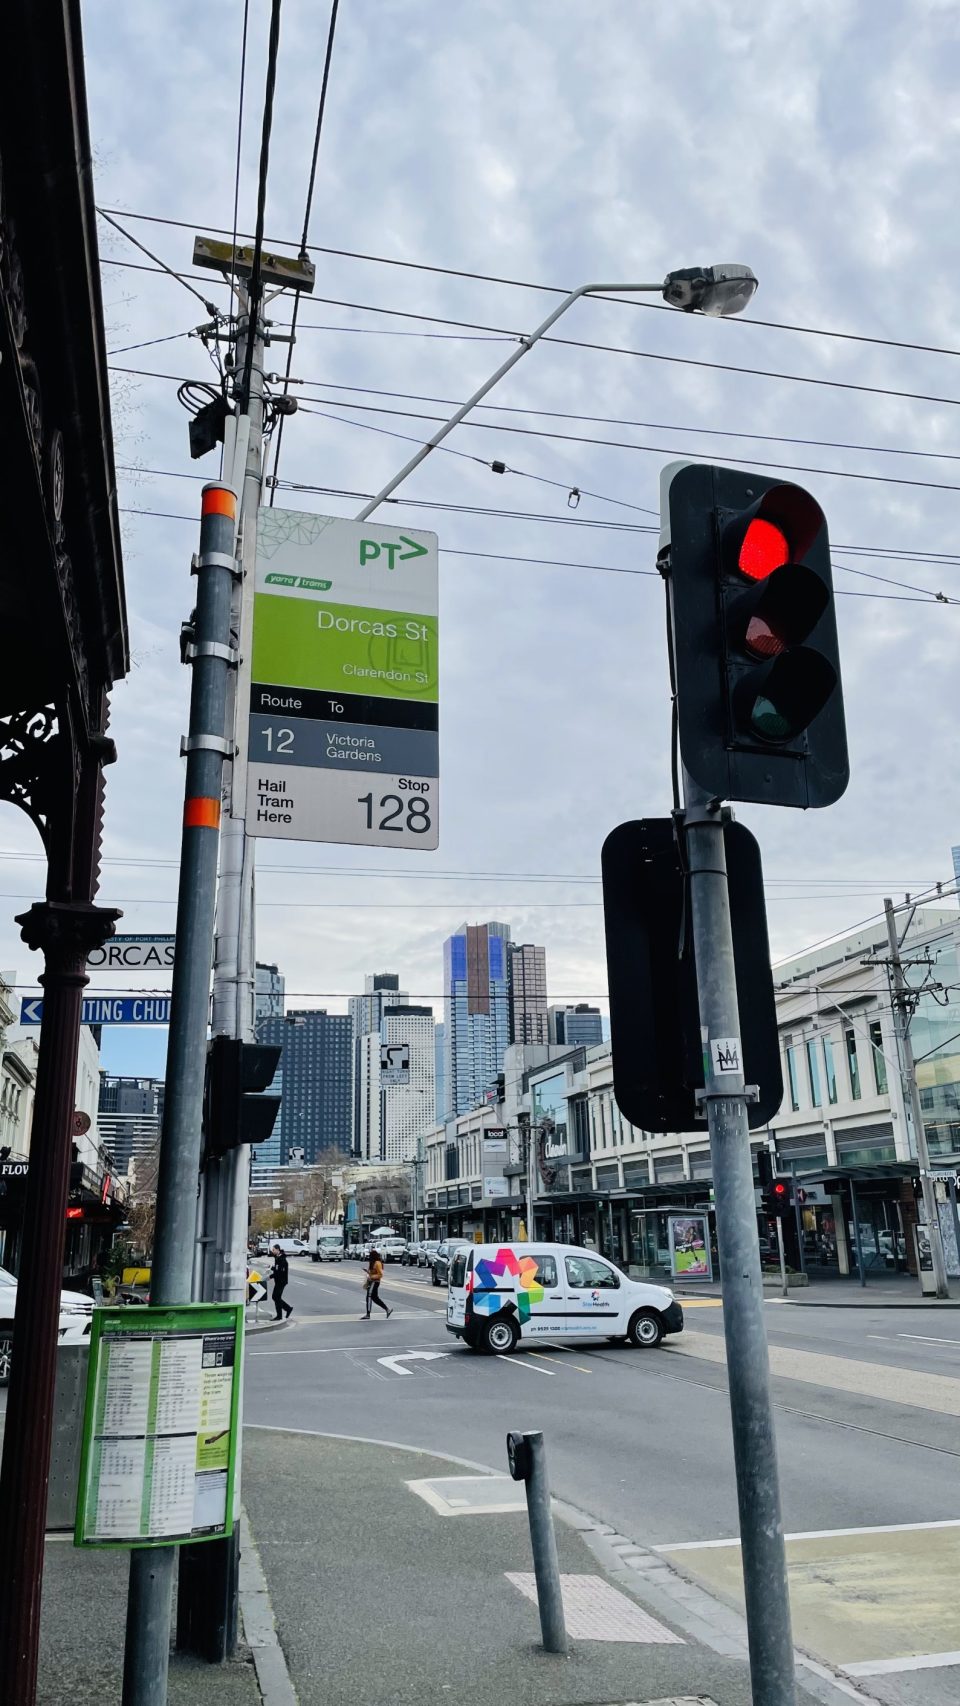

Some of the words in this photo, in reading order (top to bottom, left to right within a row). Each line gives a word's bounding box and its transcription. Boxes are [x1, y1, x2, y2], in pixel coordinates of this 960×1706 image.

[270, 575, 294, 584] yarra
[302, 579, 328, 588] trams
[317, 611, 397, 638] Dorcas
[405, 621, 429, 641] St
[342, 664, 411, 682] Clarendon
[415, 671, 428, 684] St
[261, 693, 302, 709] Route
[328, 700, 344, 714] To
[261, 728, 294, 754] 12
[326, 733, 376, 748] Victoria
[326, 748, 382, 762] Gardens
[257, 778, 286, 793] Hail
[398, 777, 430, 793] Stop
[257, 794, 294, 809] Tram
[257, 809, 292, 824] Here
[357, 792, 432, 834] 128
[87, 946, 175, 966] ORCAS
[82, 1000, 123, 1021] ITING
[132, 1000, 171, 1021] CHU
